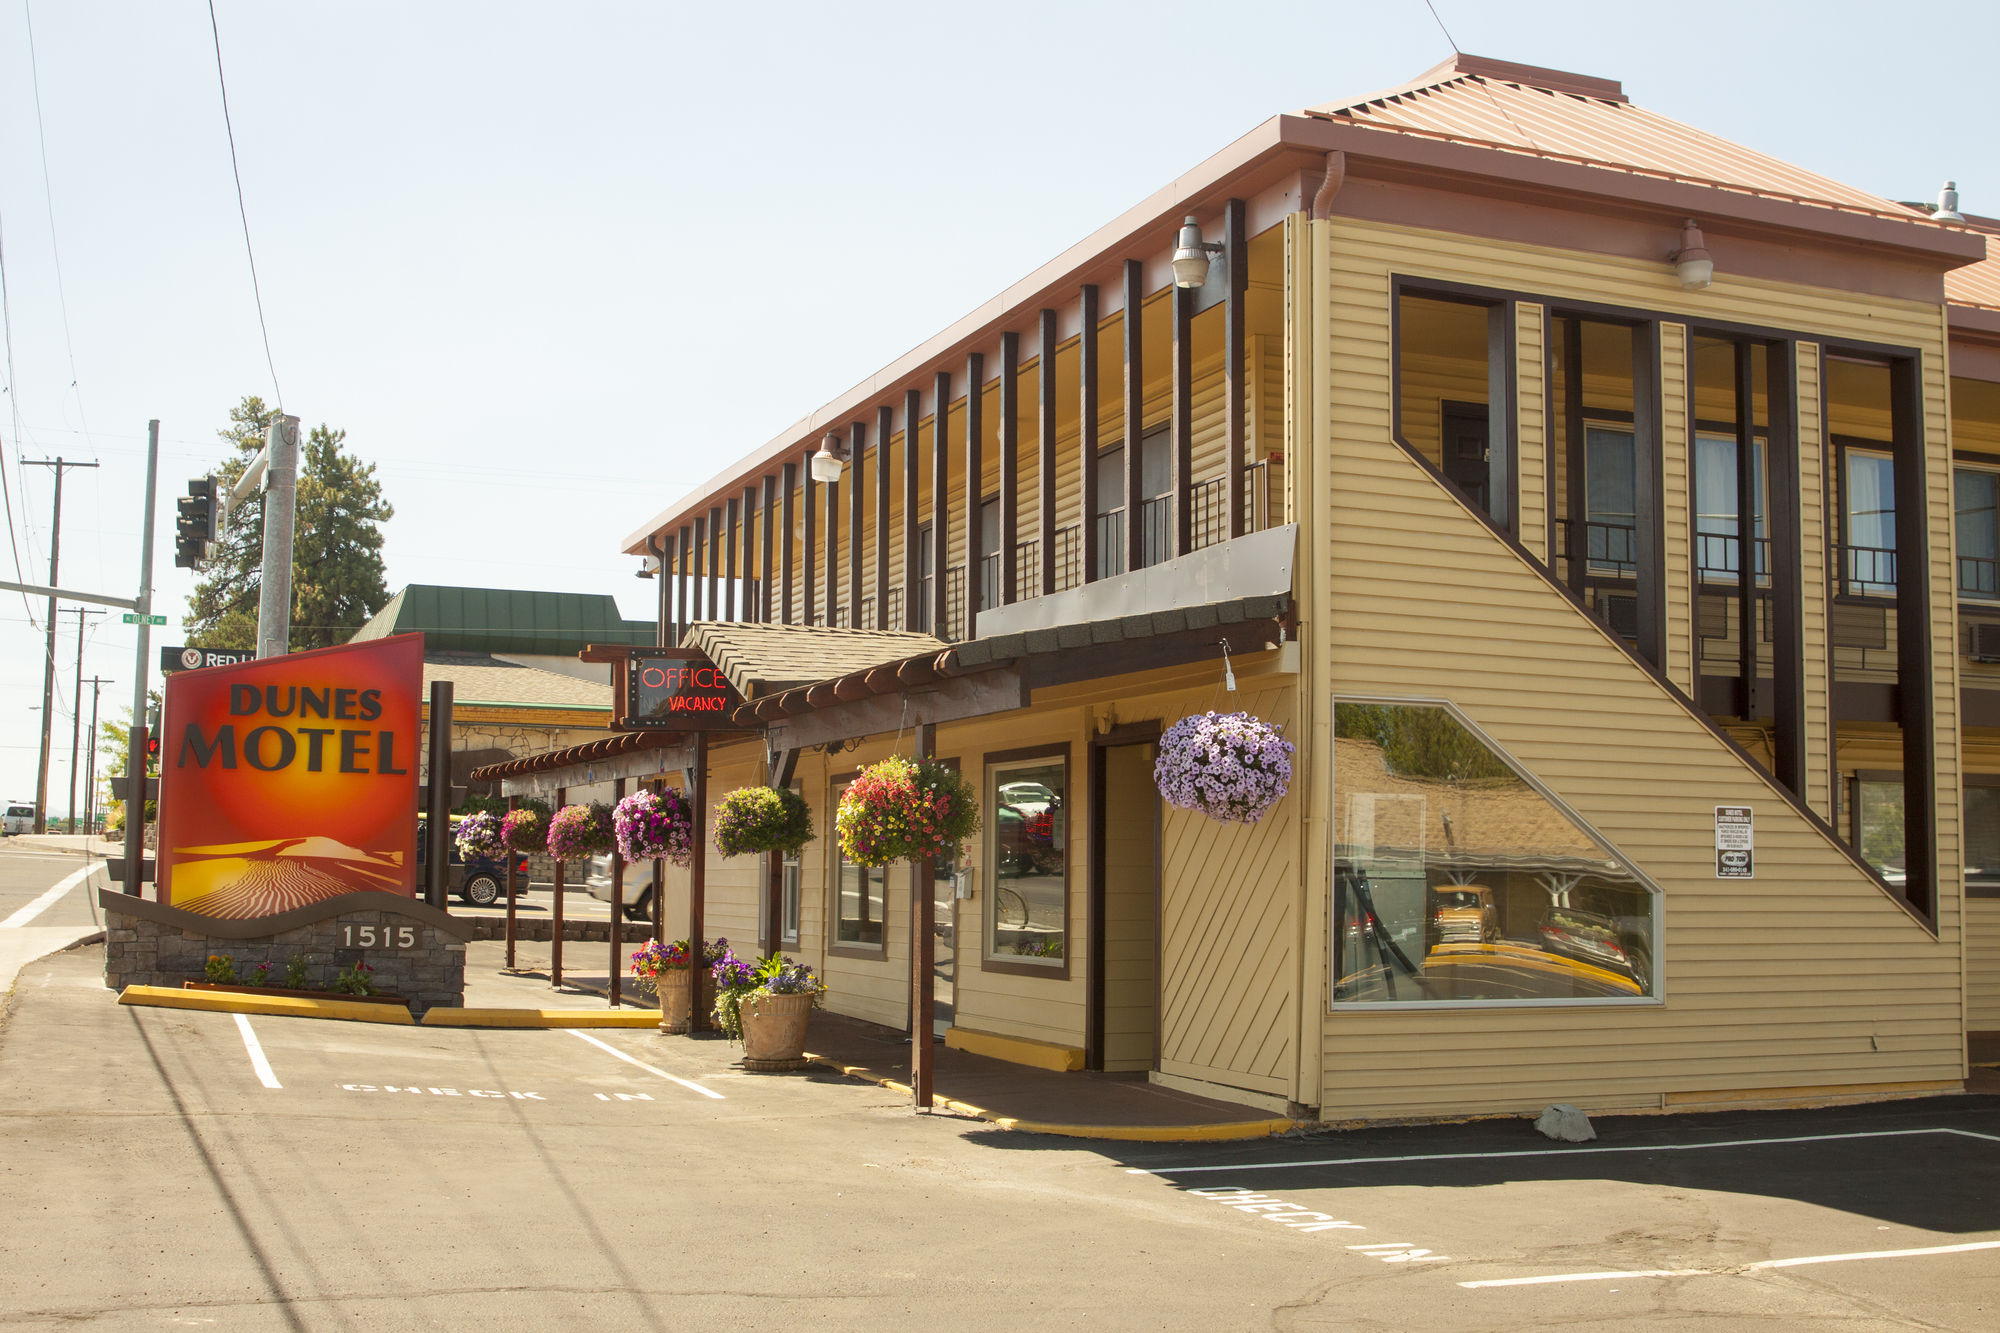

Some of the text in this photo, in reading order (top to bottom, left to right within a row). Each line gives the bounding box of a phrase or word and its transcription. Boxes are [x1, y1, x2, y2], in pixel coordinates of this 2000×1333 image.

[132, 614, 155, 624] OLNEY
[206, 653, 237, 667] RED
[642, 667, 726, 688] OFFICE
[229, 684, 382, 721] DUNES
[668, 696, 727, 711] VACANCY
[177, 723, 407, 775] MOTEL
[344, 925, 415, 948] 1515
[338, 1083, 655, 1101] CHECK IN
[1186, 1186, 1452, 1263] CHECK IN
